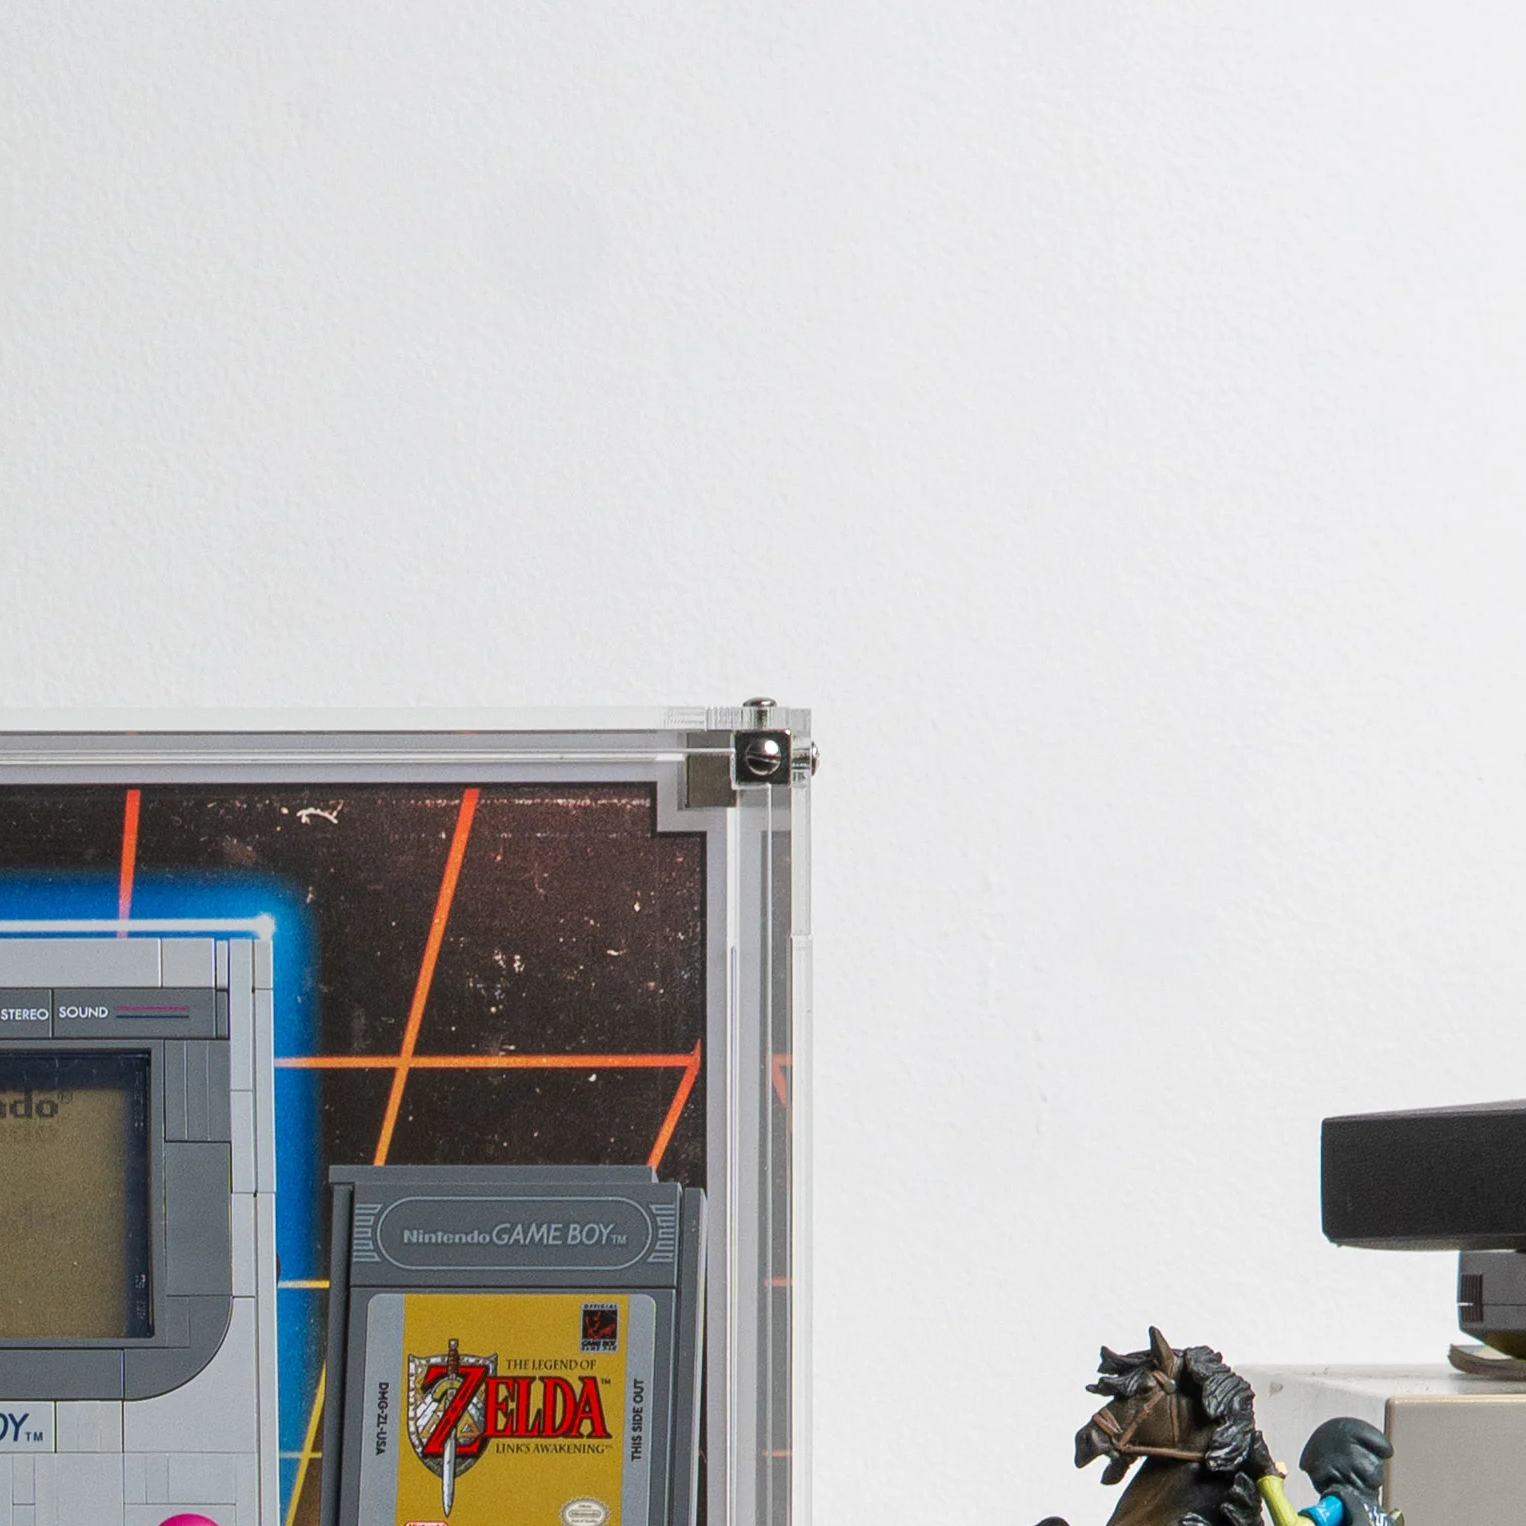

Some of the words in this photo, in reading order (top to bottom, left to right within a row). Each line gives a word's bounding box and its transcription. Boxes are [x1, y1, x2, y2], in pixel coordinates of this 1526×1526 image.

[0, 1008, 49, 1022] STEREO
[58, 1006, 108, 1020] SOUND
[403, 1229, 490, 1244] Nintendo
[492, 1223, 564, 1245] GAME
[506, 1359, 529, 1370] THE
[531, 1359, 578, 1370] LEGEND
[580, 1359, 596, 1371] OF
[633, 1378, 644, 1404] OUT
[376, 1382, 389, 1456] DMG-ZL-USA
[632, 1407, 643, 1433] SIDE
[631, 1435, 642, 1461] THIS
